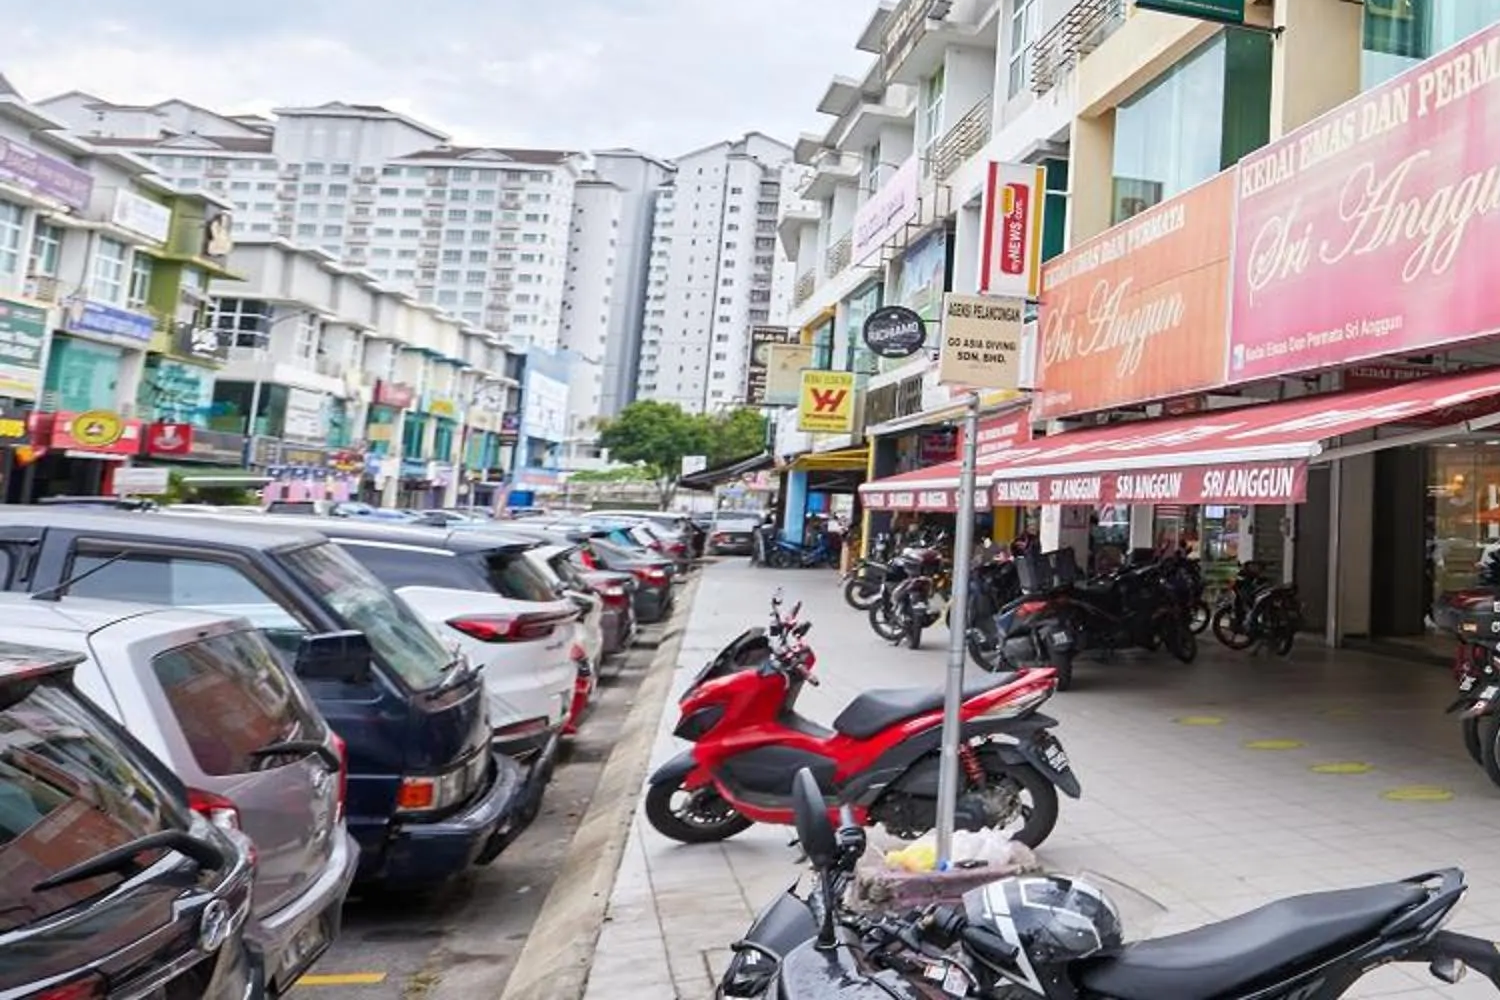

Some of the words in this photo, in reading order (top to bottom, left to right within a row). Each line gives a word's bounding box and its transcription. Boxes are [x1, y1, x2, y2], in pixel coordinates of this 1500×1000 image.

[1241, 152, 1296, 199] KEDAI
[1300, 110, 1356, 174] EMAS
[1355, 84, 1411, 141] DAN
[1201, 469, 1224, 498] SRI
[1225, 467, 1294, 498] ANGGUN
